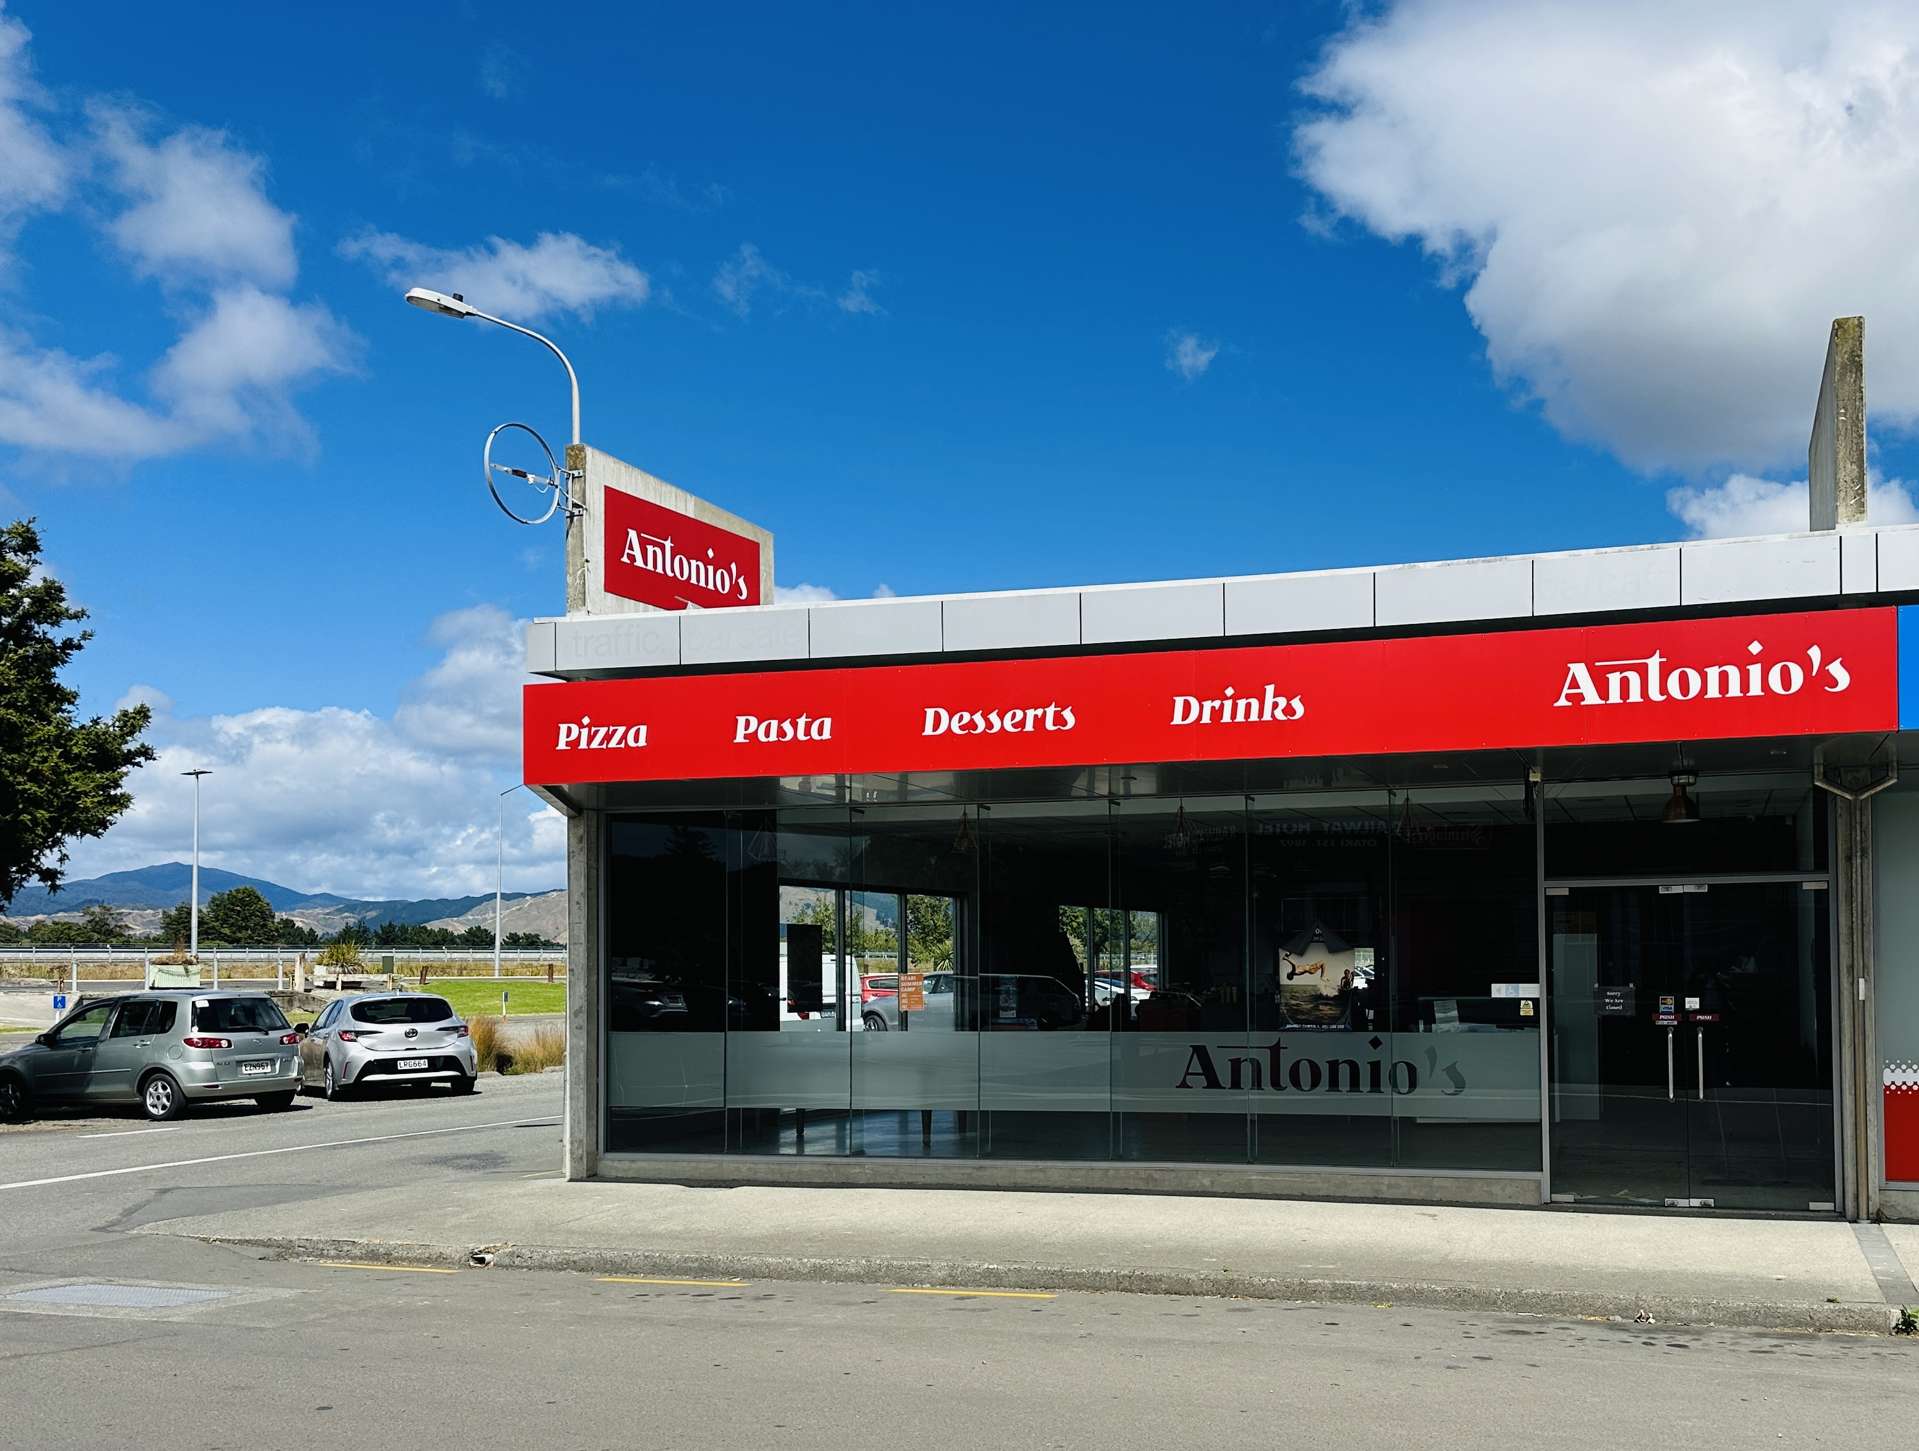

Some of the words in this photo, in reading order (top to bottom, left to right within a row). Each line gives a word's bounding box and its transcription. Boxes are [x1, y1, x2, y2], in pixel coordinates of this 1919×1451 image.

[620, 528, 748, 600] Antonio's
[1554, 640, 1851, 707] Antonio's
[556, 715, 648, 750] Pizza
[733, 712, 832, 743] Pasta
[922, 701, 1076, 736] Desserts
[1171, 683, 1305, 725] Drinks
[1176, 1035, 1466, 1096] Antonio's
